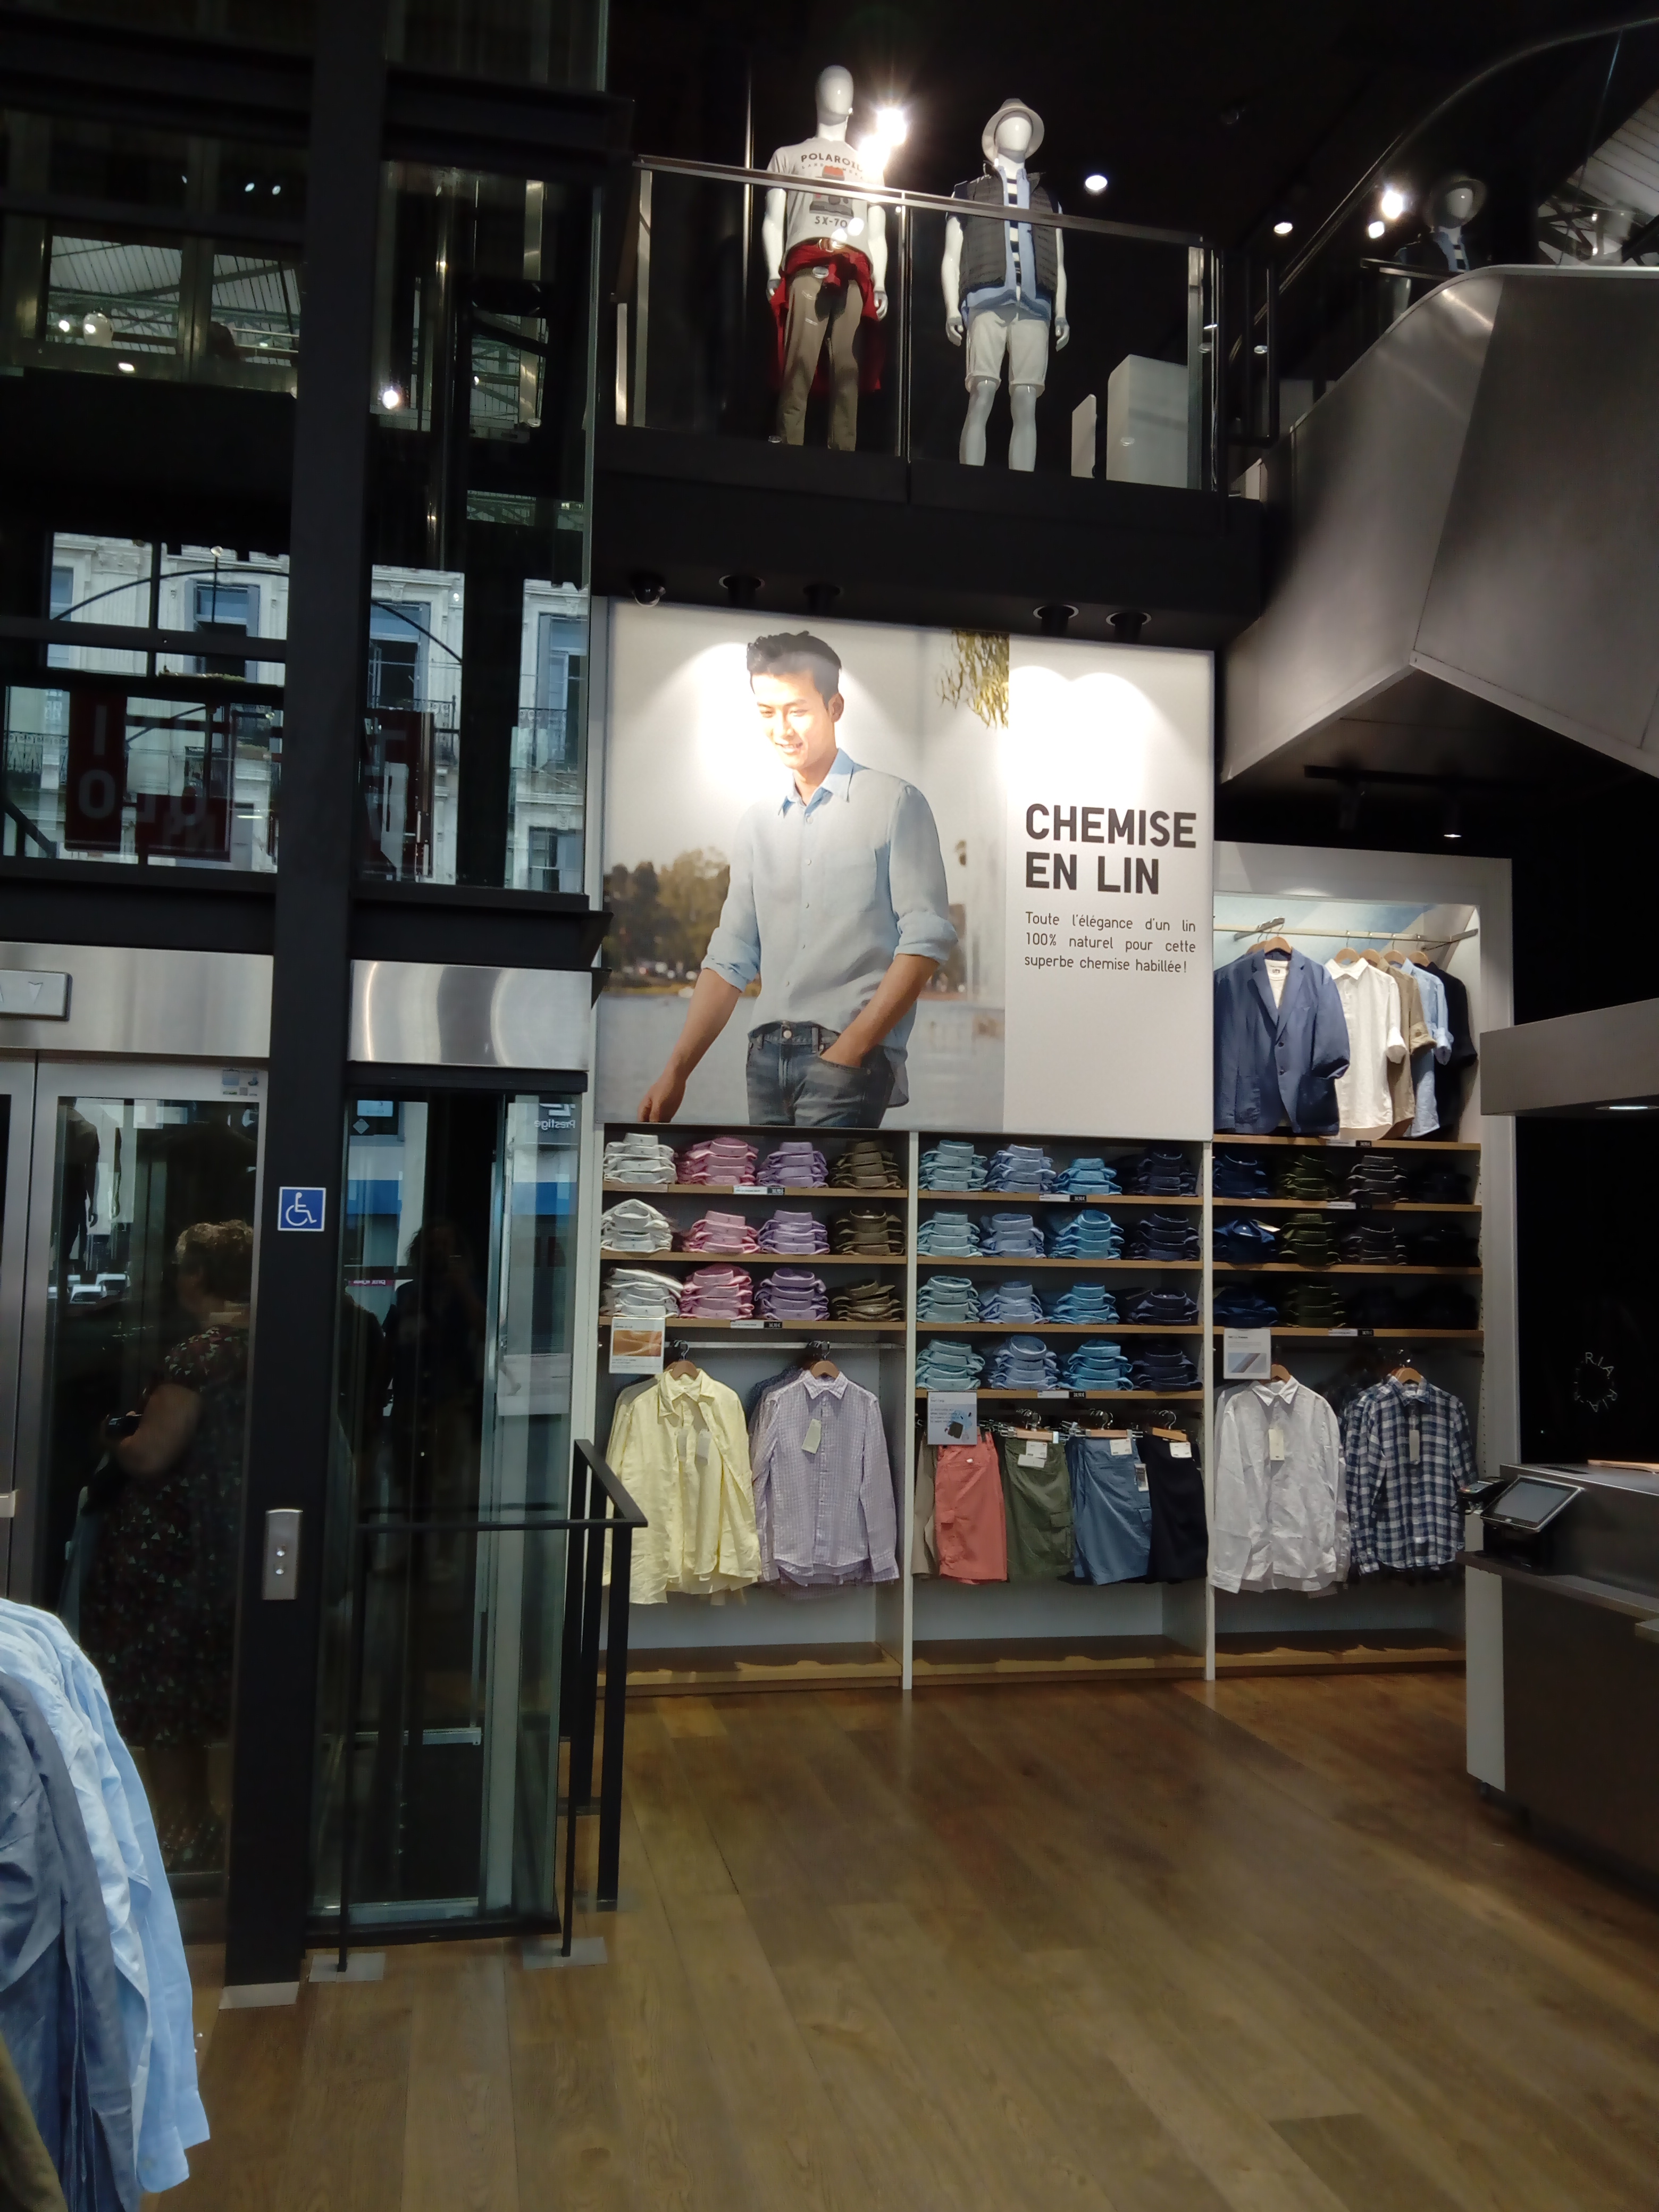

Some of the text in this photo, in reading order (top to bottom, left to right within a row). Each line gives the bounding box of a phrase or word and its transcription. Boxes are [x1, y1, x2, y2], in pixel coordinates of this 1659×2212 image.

[815, 216, 848, 228] SX-70
[1026, 803, 1196, 848] CHEMISE
[1026, 851, 1159, 894] EN LIN
[1025, 911, 1196, 932] Toute l'élégance d'un lin
[1026, 932, 1196, 952] 100% naturel pour cette
[1025, 956, 1074, 969] superbe
[1079, 957, 1130, 970] chemise
